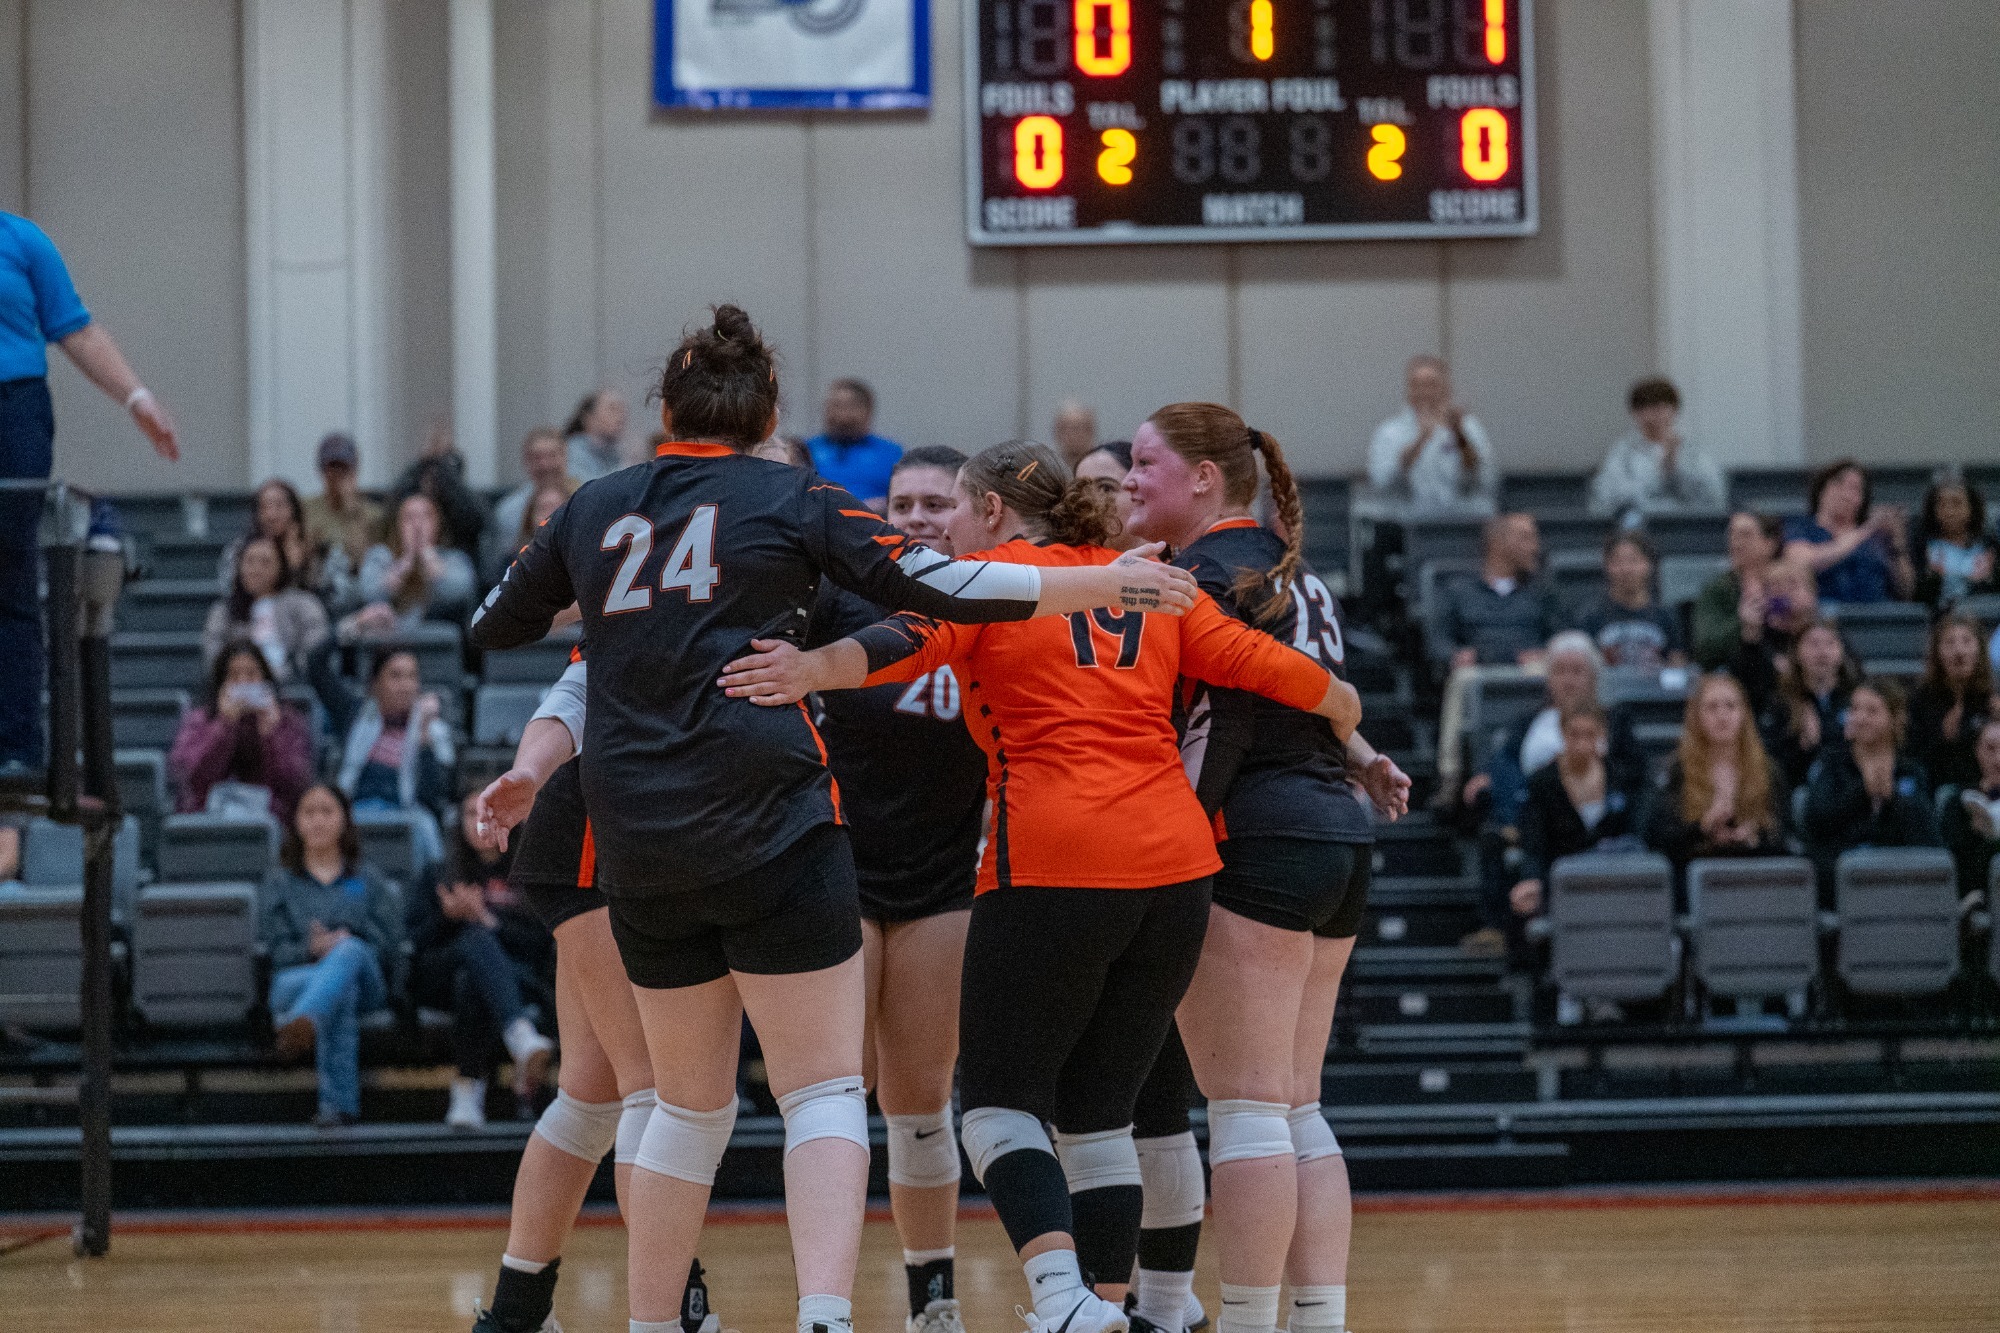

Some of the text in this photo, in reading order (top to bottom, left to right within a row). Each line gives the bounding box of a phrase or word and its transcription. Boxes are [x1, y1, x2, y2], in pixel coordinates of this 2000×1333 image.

[1075, 0, 1131, 76] 0
[982, 82, 1074, 117] FOULS
[1160, 77, 1346, 113] PLAYER FOUL
[1426, 75, 1519, 109] FOULS
[1015, 115, 1063, 189] 0
[1097, 127, 1136, 185] 2
[1367, 123, 1406, 181] 2
[1461, 108, 1508, 181] 0
[984, 197, 1076, 228] SCORE
[1202, 193, 1304, 224] MATCH
[1430, 190, 1521, 221] SCORE
[600, 503, 720, 615] 24
[1061, 606, 1146, 669] 19
[1273, 572, 1344, 664] 23
[893, 663, 961, 721] 20
